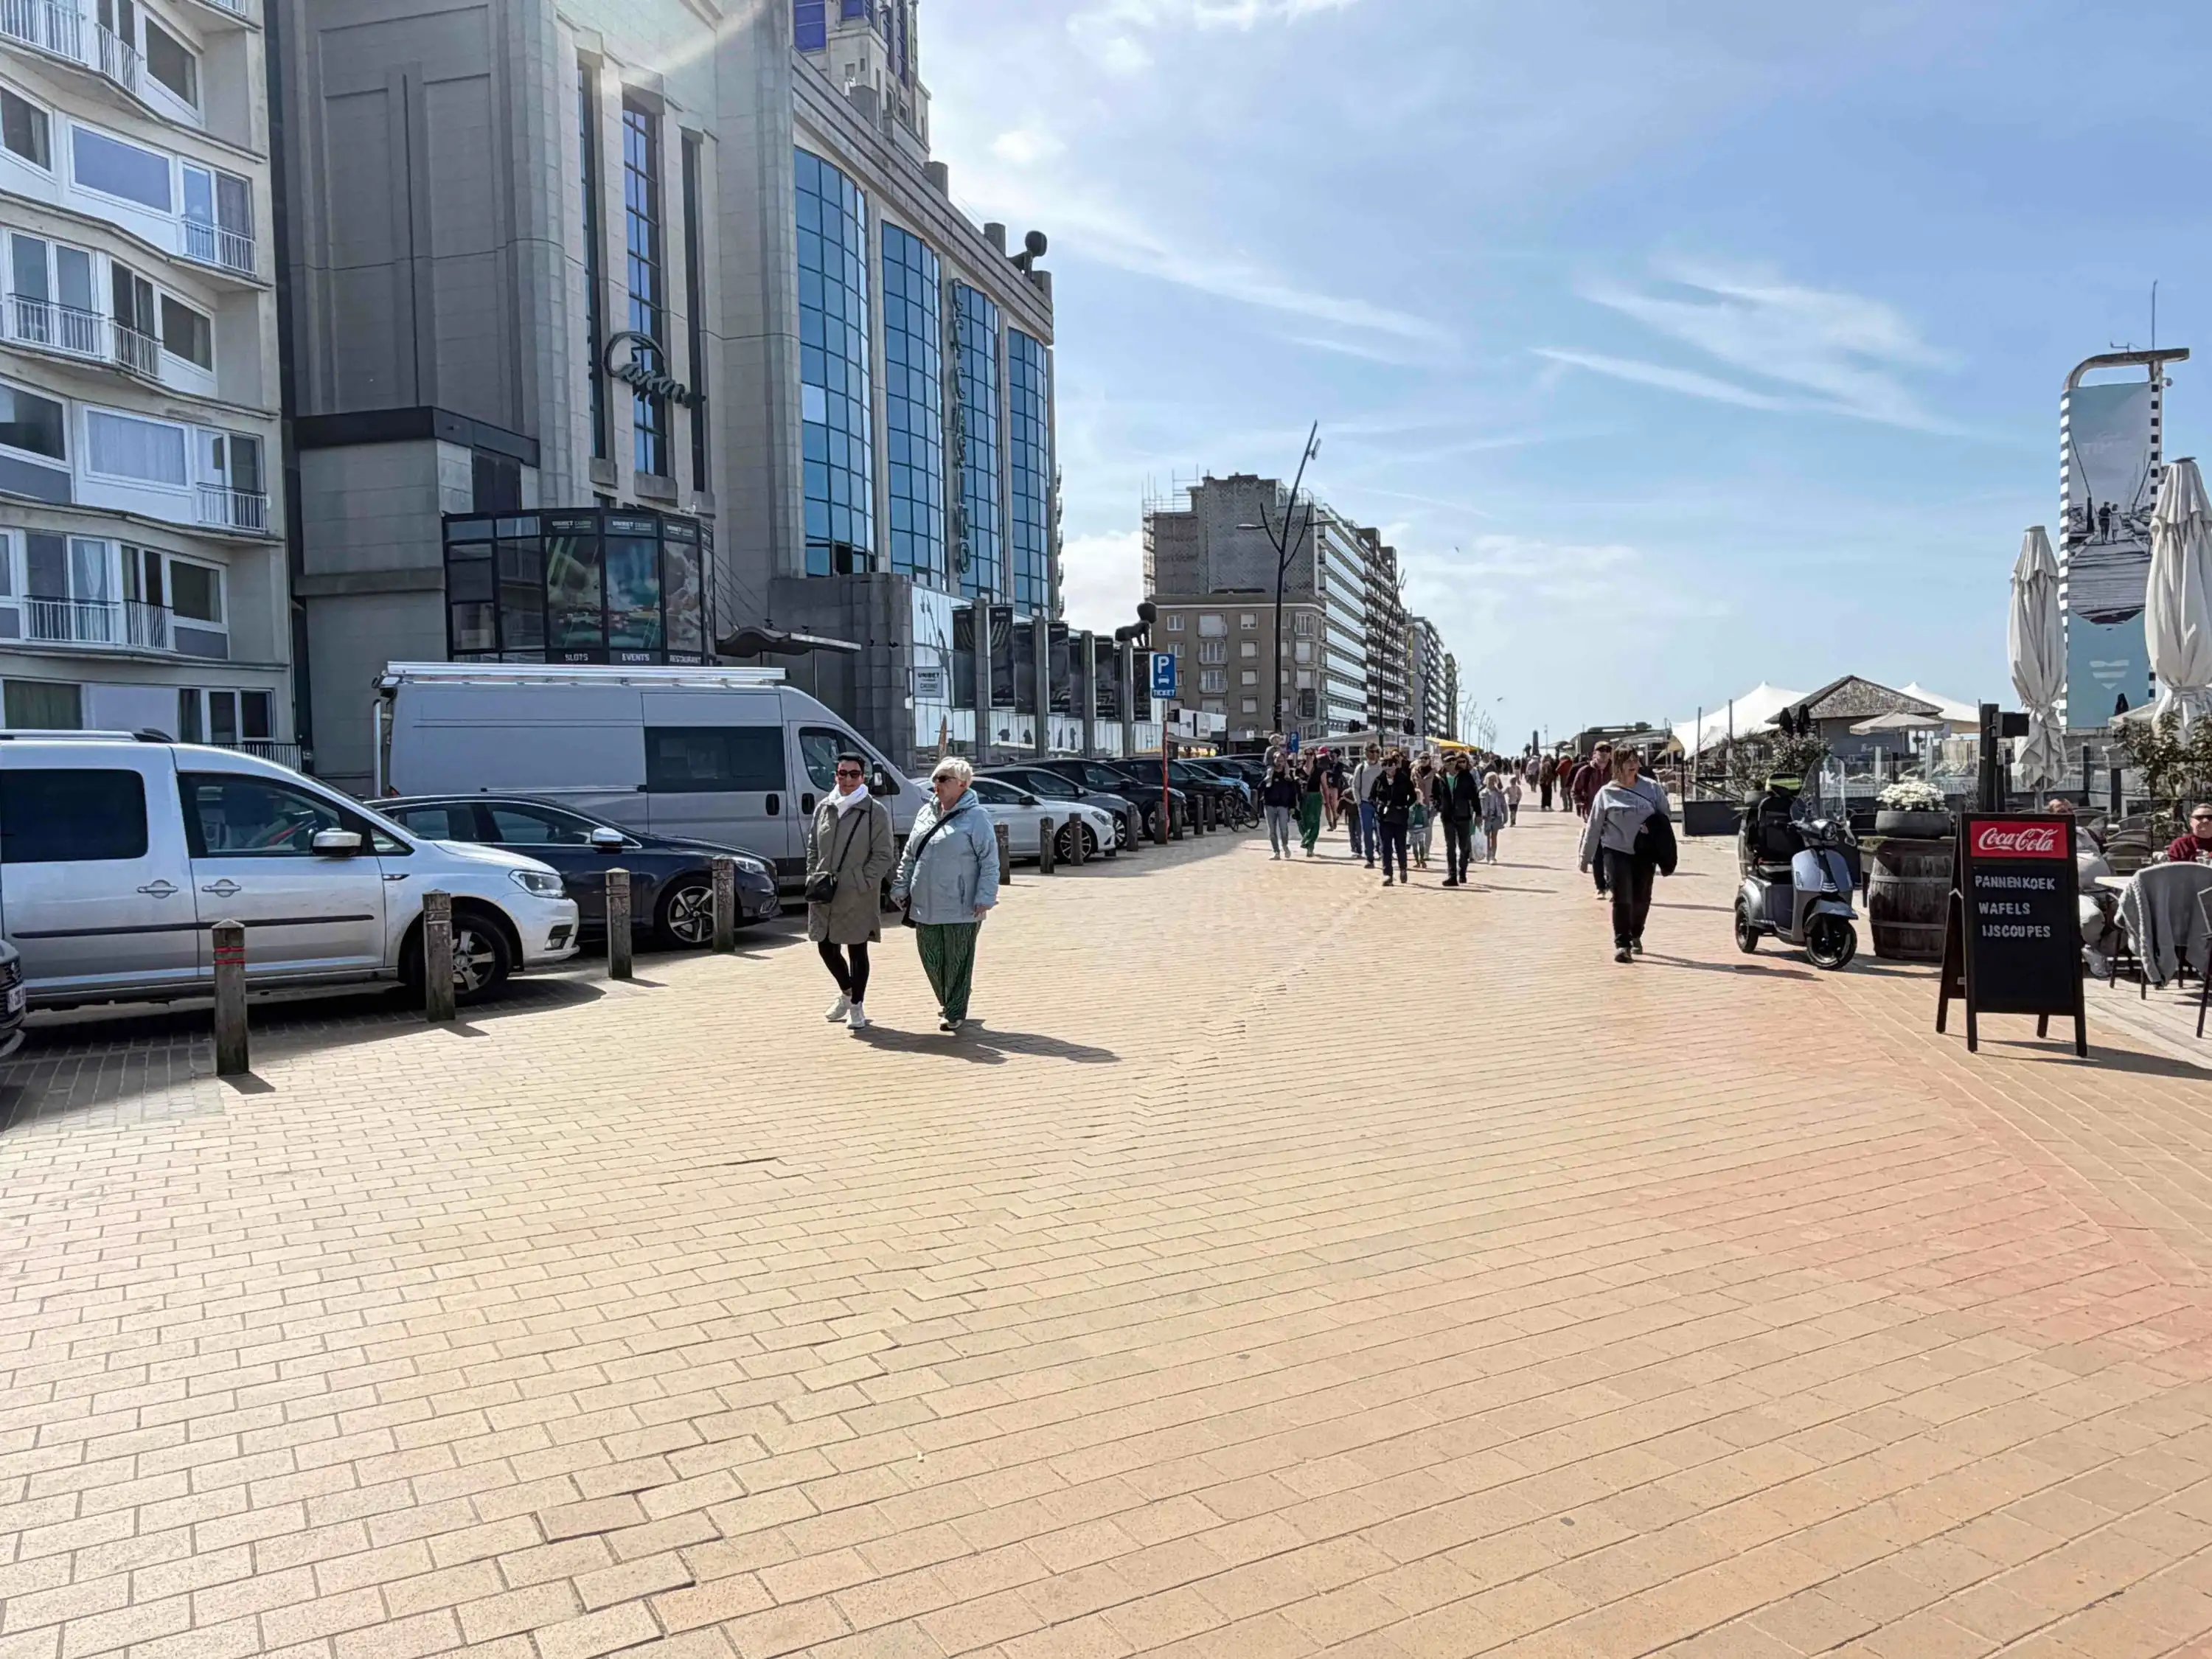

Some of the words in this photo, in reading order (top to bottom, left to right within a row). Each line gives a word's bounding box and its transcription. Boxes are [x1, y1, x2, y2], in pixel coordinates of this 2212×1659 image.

[565, 653, 588, 661] SLOTS
[622, 653, 650, 662] EVENTS
[1157, 655, 1169, 674] P
[1978, 827, 2059, 851] Coca-Cola
[1975, 875, 2056, 890] PANNENKOEK
[1978, 902, 2031, 915] WAFELS
[1982, 925, 2051, 938] IJSCOUPES
